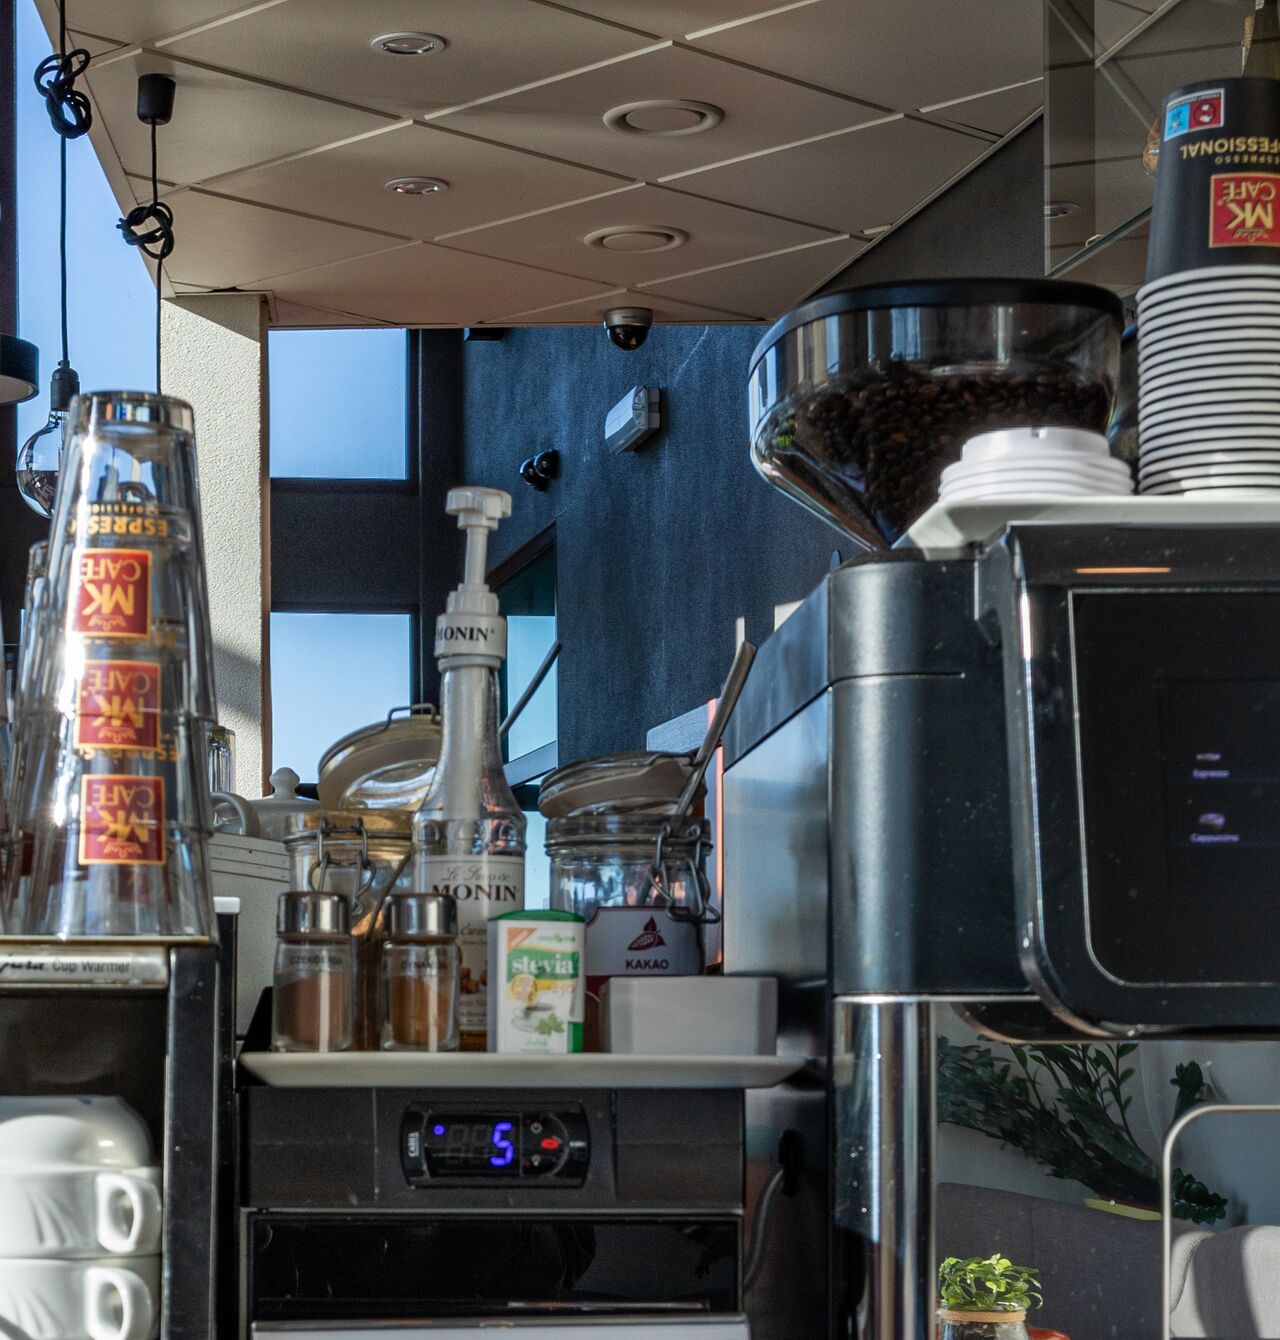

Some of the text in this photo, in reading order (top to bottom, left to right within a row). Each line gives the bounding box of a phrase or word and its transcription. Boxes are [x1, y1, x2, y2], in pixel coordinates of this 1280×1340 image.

[1215, 154, 1280, 166] ESPRESSO
[1226, 202, 1274, 229] MK
[82, 583, 135, 616] MK
[91, 695, 145, 729] MK
[97, 810, 150, 843] MK
[51, 958, 77, 974] Cup
[81, 959, 131, 974] Warmer
[511, 953, 575, 975] stevia
[625, 959, 670, 970] KAKAO
[489, 1121, 515, 1166] 5
